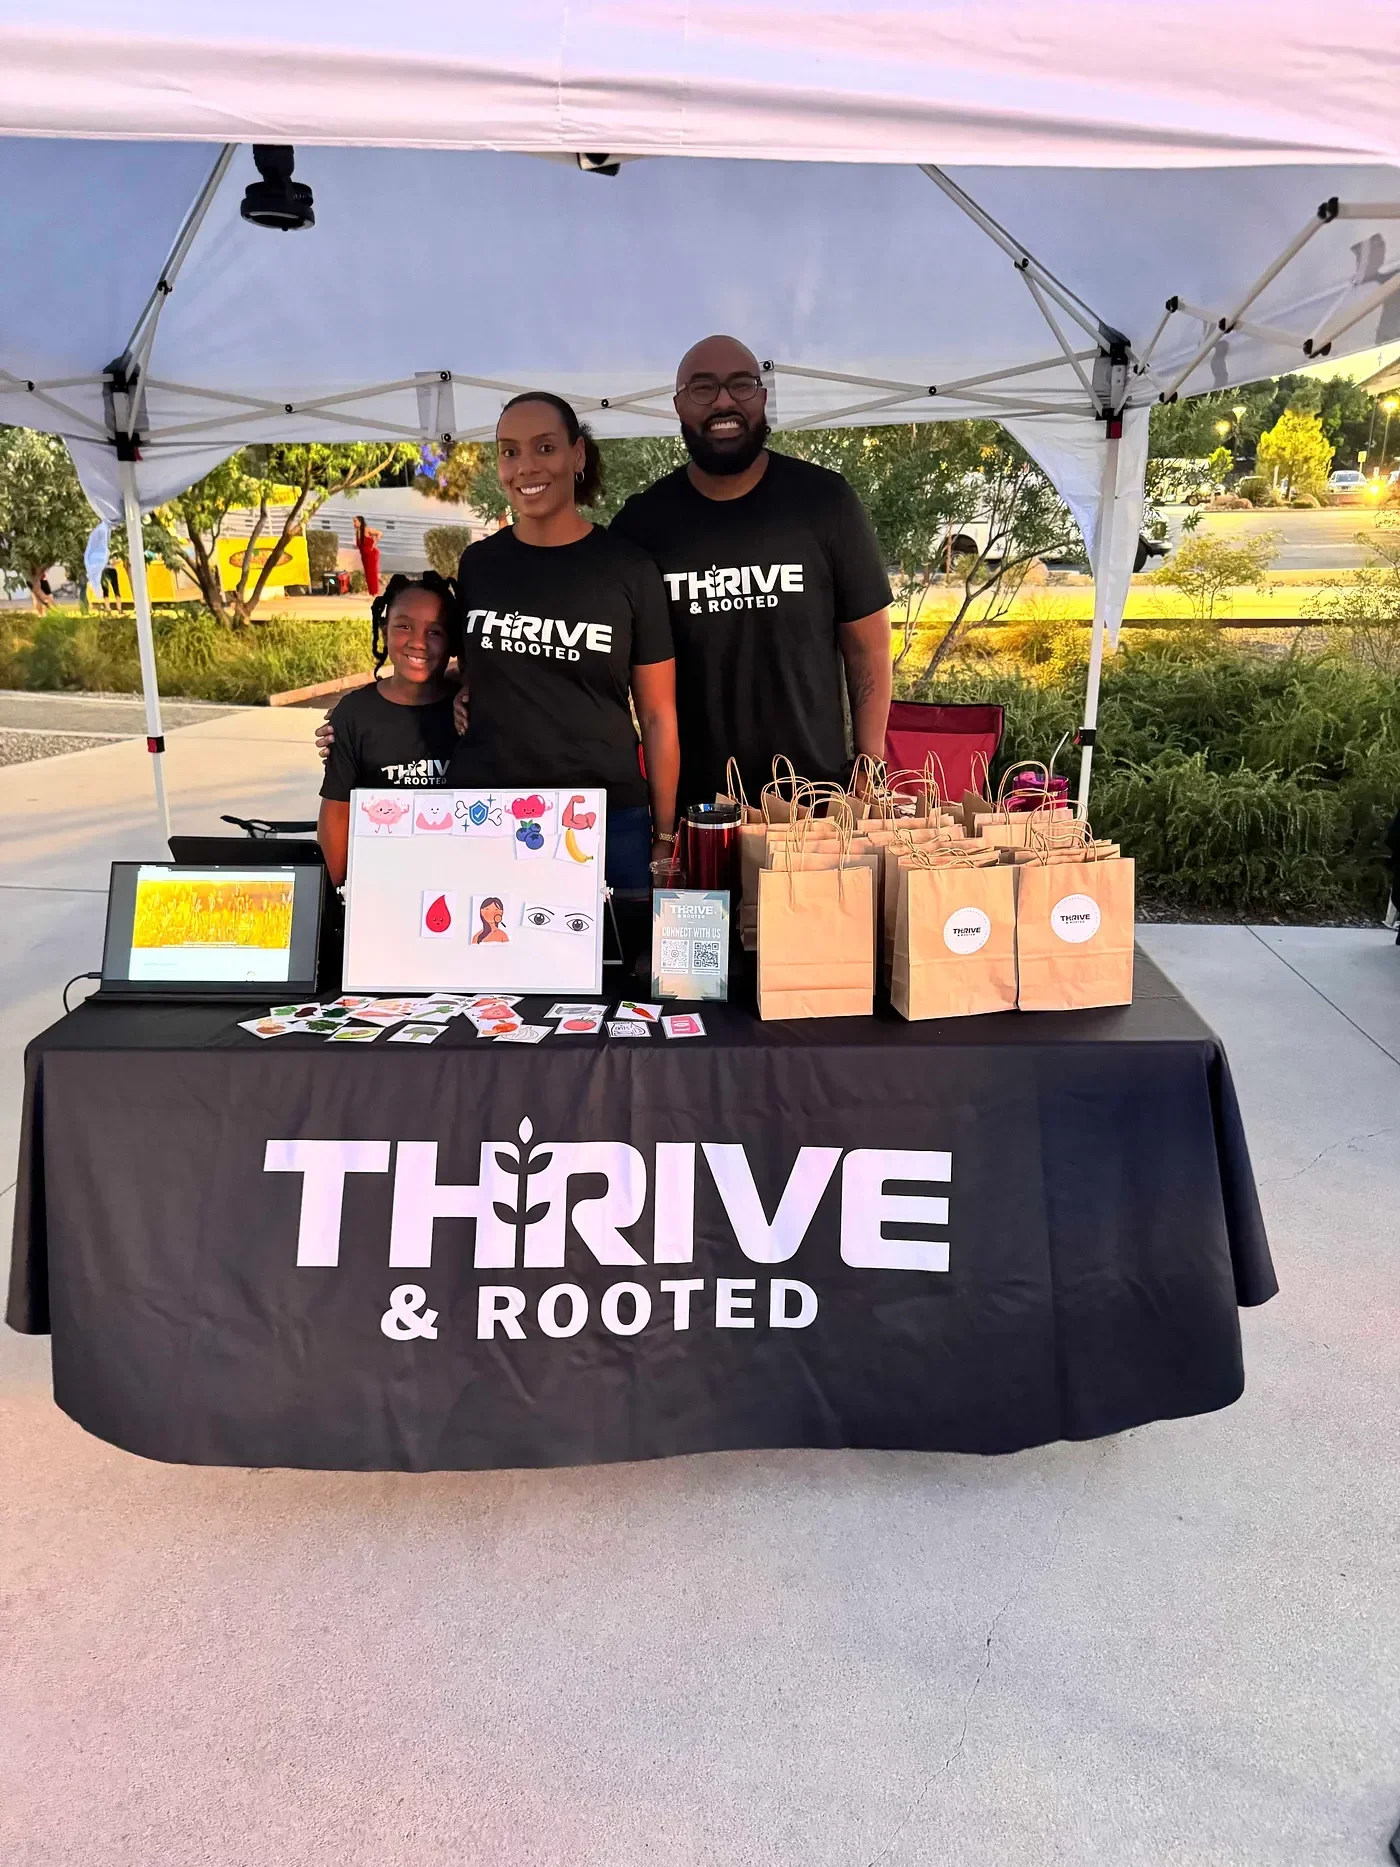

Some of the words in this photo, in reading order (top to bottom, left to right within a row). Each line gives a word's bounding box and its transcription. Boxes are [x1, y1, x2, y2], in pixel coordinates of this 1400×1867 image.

[663, 564, 804, 601] THRIVE
[689, 602, 702, 614] &
[708, 595, 779, 613] ROOTED
[466, 609, 613, 654] THRIVE
[480, 636, 494, 650] &
[501, 639, 580, 661] ROOTED
[381, 759, 451, 780] THRIV
[404, 776, 447, 785] ROOTED
[669, 904, 714, 915] THRIVE
[662, 926, 692, 937] CONNECT
[693, 927, 711, 938] WITH
[712, 928, 721, 938] US
[264, 1138, 954, 1273] THRIVE
[380, 1283, 439, 1340] &
[477, 1278, 819, 1340] ROOTED
